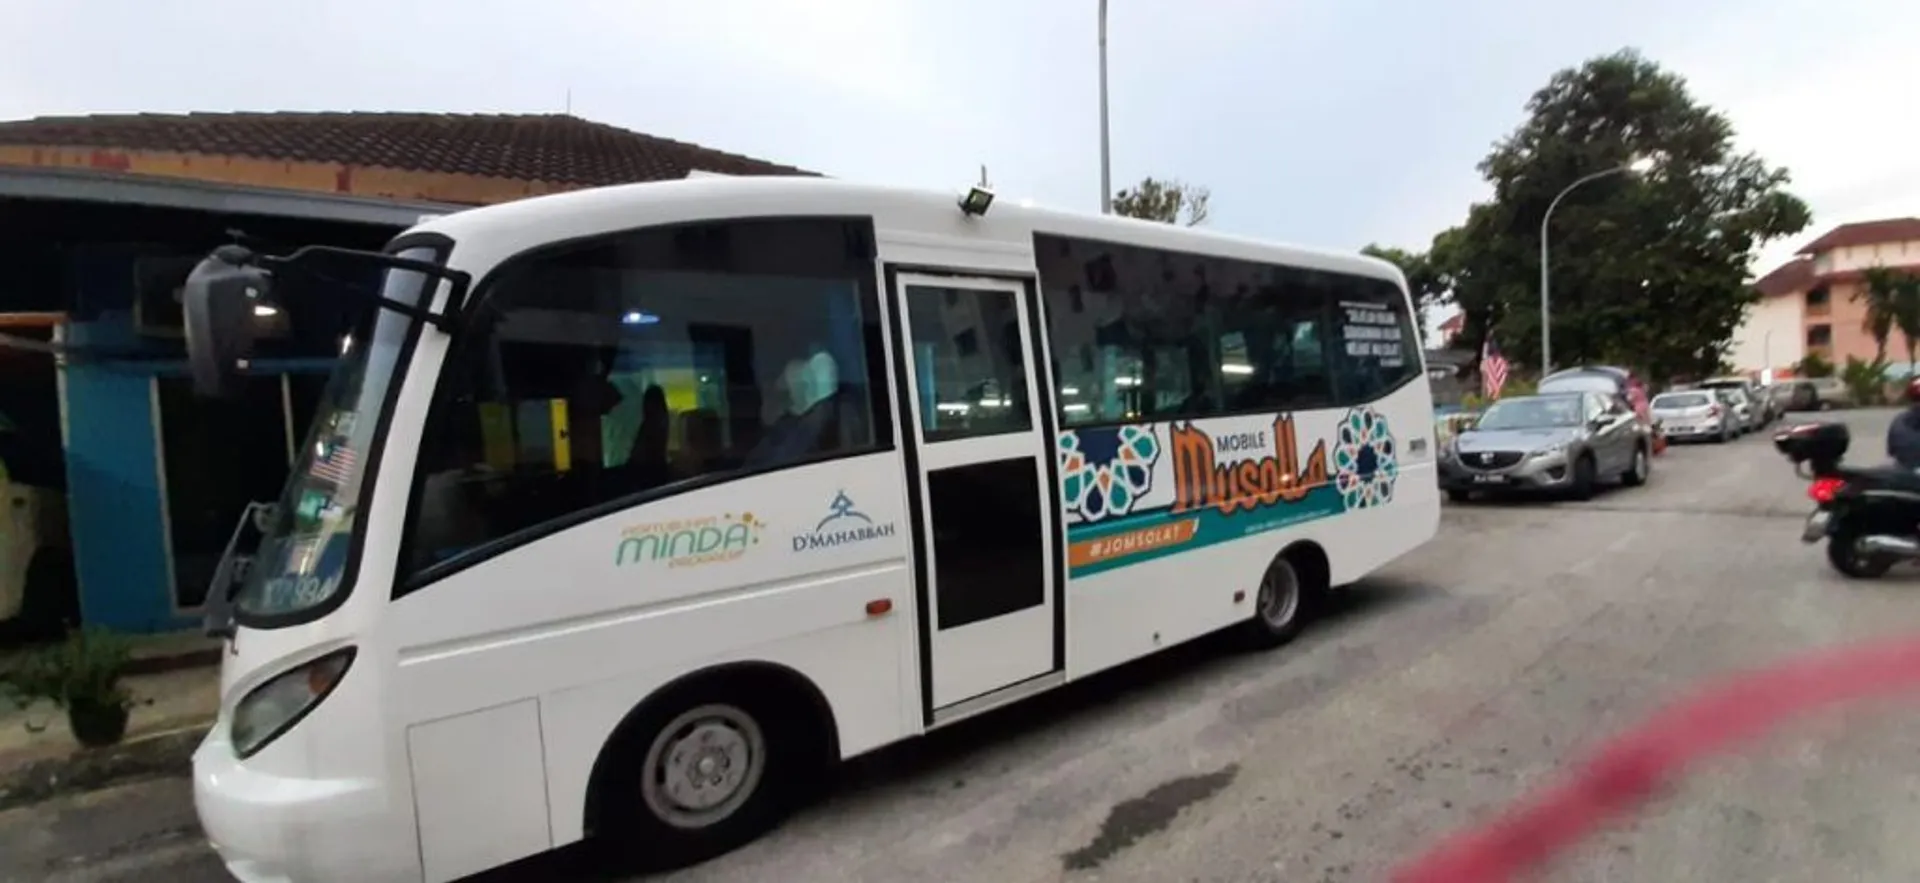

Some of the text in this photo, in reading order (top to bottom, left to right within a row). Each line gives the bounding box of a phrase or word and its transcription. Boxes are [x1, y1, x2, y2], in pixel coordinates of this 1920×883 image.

[1216, 431, 1266, 453] MOBILE
[615, 522, 750, 568] MINDA
[792, 521, 896, 552] D'MAHABBAH
[1089, 525, 1180, 557] #JOMSOLAT
